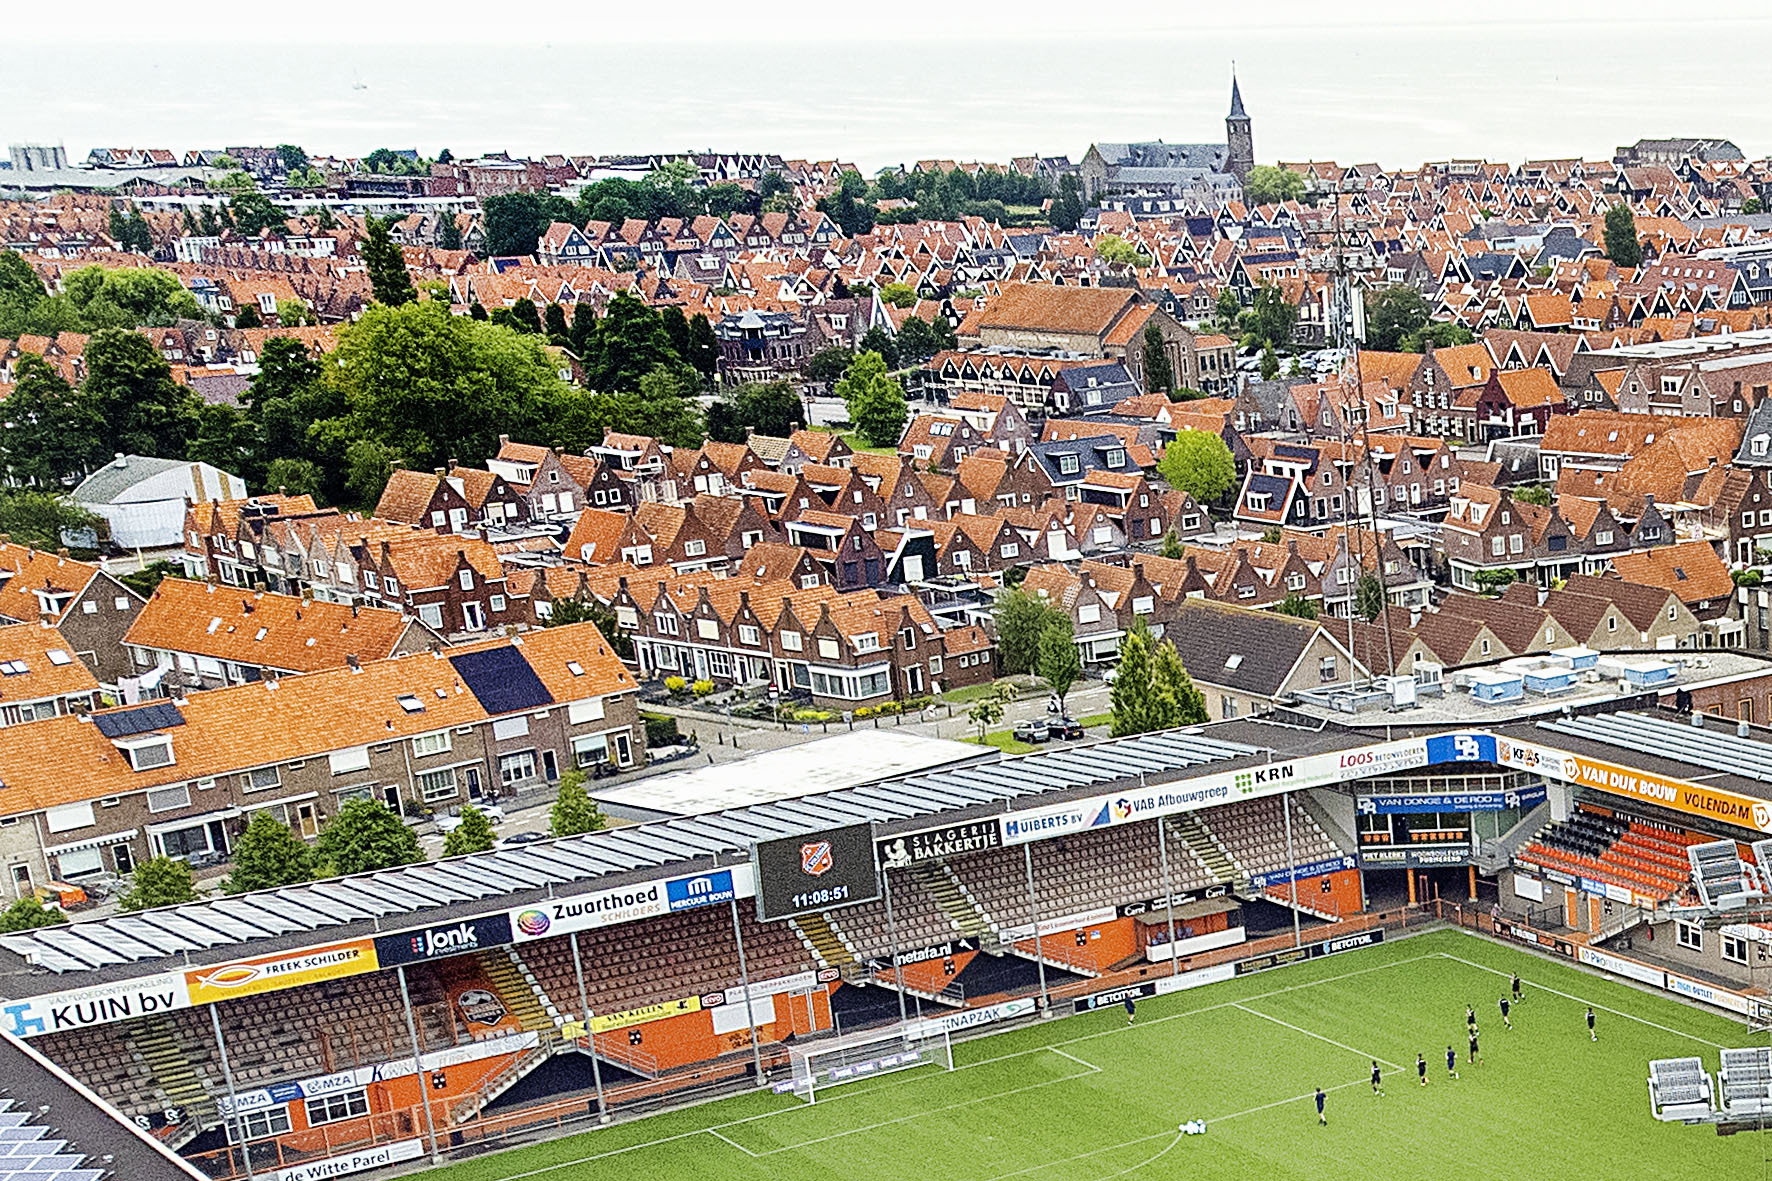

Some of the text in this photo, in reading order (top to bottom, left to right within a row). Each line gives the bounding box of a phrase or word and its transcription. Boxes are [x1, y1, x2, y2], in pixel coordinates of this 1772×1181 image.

[1339, 751, 1374, 769] LOOS
[1255, 765, 1294, 784] KRN
[1133, 785, 1228, 812] VAB Afbouwgroep
[1379, 798, 1402, 806] VAN
[1403, 797, 1442, 806] DONGE
[1582, 765, 1750, 820] VAN DIJK BOUW VOLENDAM
[1071, 813, 1083, 824] BV
[912, 822, 996, 847] SLAGERIJ
[914, 832, 998, 861] BAKKERTJE
[553, 886, 659, 920] Zwarthoed
[670, 889, 734, 909] MERCUUR BOUW
[792, 885, 849, 908] 11:08:51
[601, 904, 661, 923] SCHILDERS
[425, 923, 478, 956] Jonk
[266, 949, 361, 975] FREEK SCHILDER
[50, 976, 174, 1006] VASTGOEDONTWIKKELING
[52, 991, 175, 1029] KUIN bv
[322, 1075, 351, 1089] MZA
[306, 1155, 350, 1180] Witte
[352, 1150, 390, 1171] Parel
